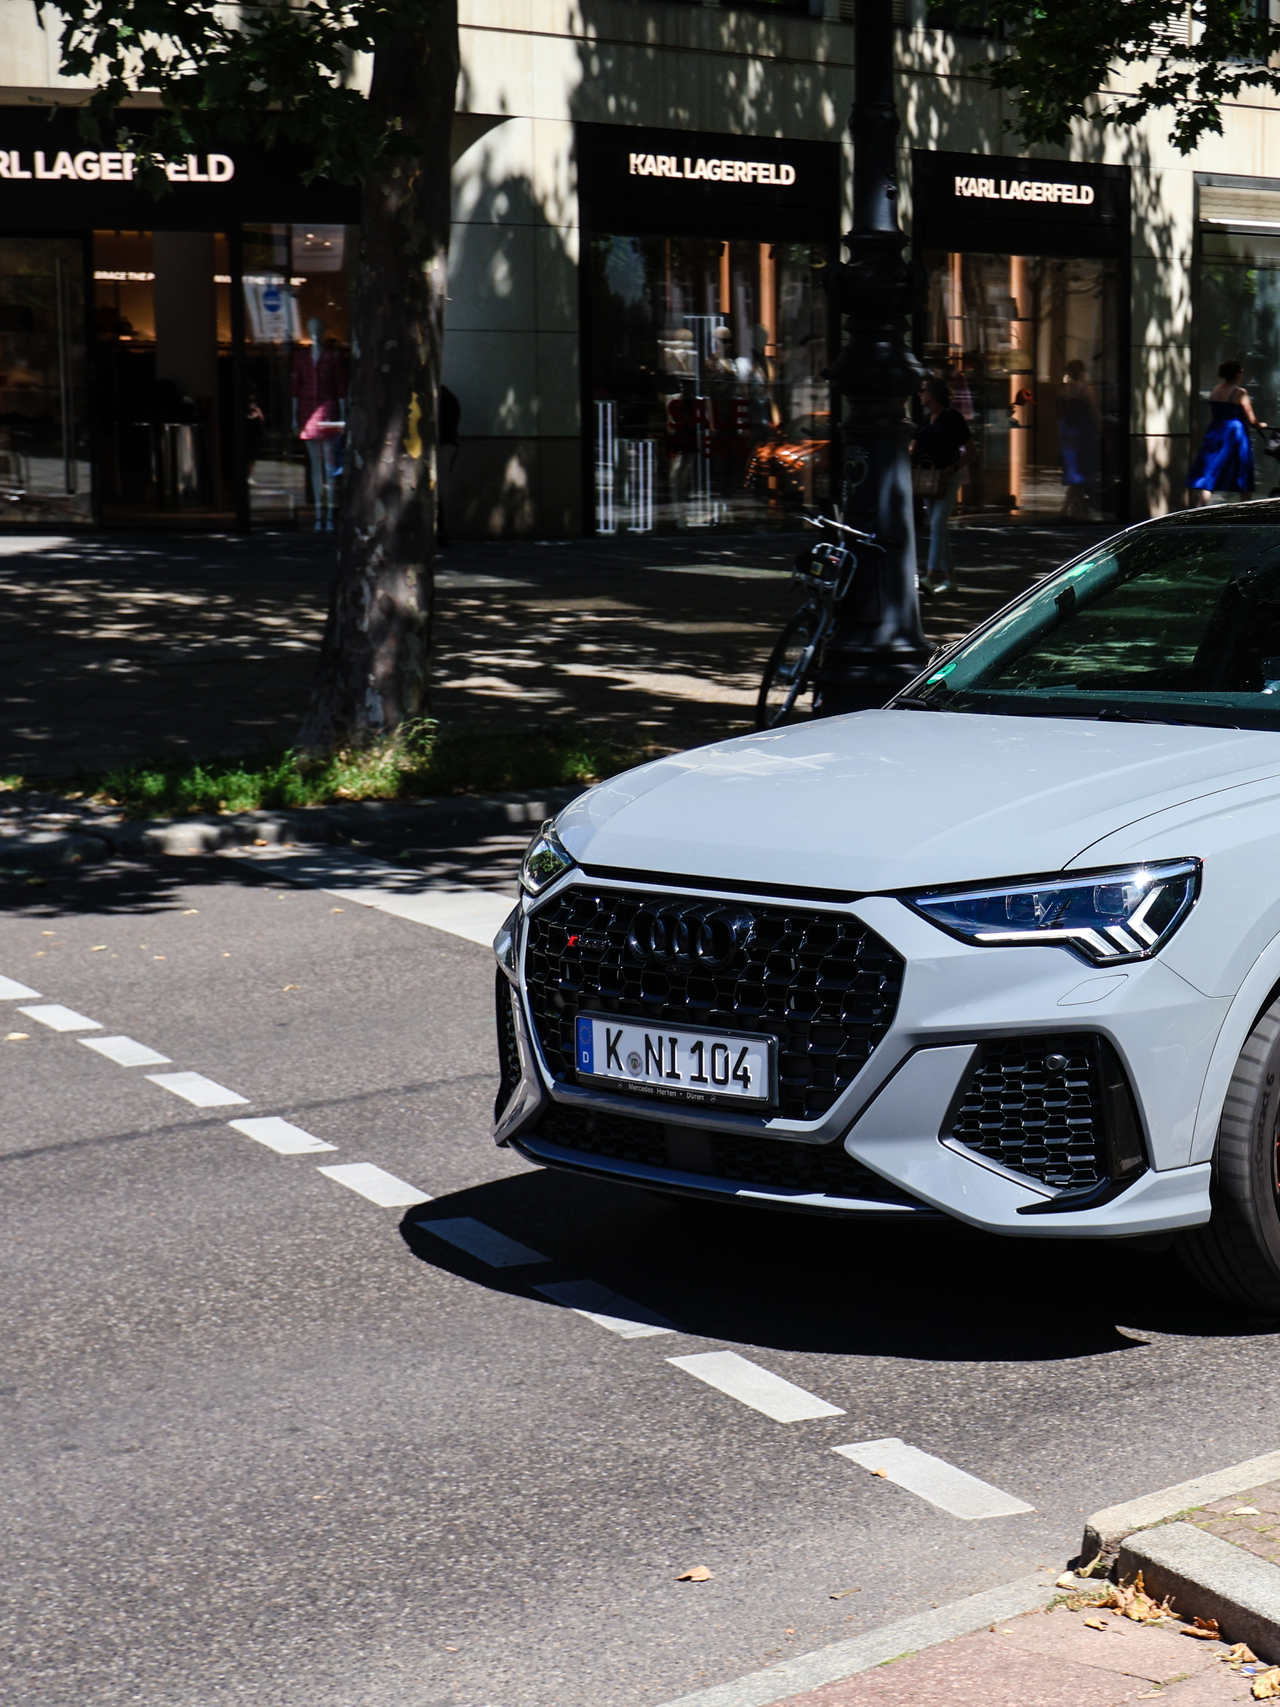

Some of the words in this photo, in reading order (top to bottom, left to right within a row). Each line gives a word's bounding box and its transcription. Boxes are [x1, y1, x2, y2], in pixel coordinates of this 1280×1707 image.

[629, 153, 683, 178] KARL
[684, 157, 796, 186] LAGERFELD
[955, 176, 1000, 199] KARL
[1000, 179, 1095, 205] LAGERFELD
[667, 398, 750, 431] SALE
[582, 1051, 589, 1063] D
[606, 1027, 625, 1071] K
[644, 1033, 681, 1080] NI
[690, 1040, 752, 1089] 104
[628, 1083, 654, 1095] Mercedes
[656, 1087, 677, 1098] Herten
[686, 1091, 705, 1102] Düren
[1266, 1072, 1274, 1085] 6
